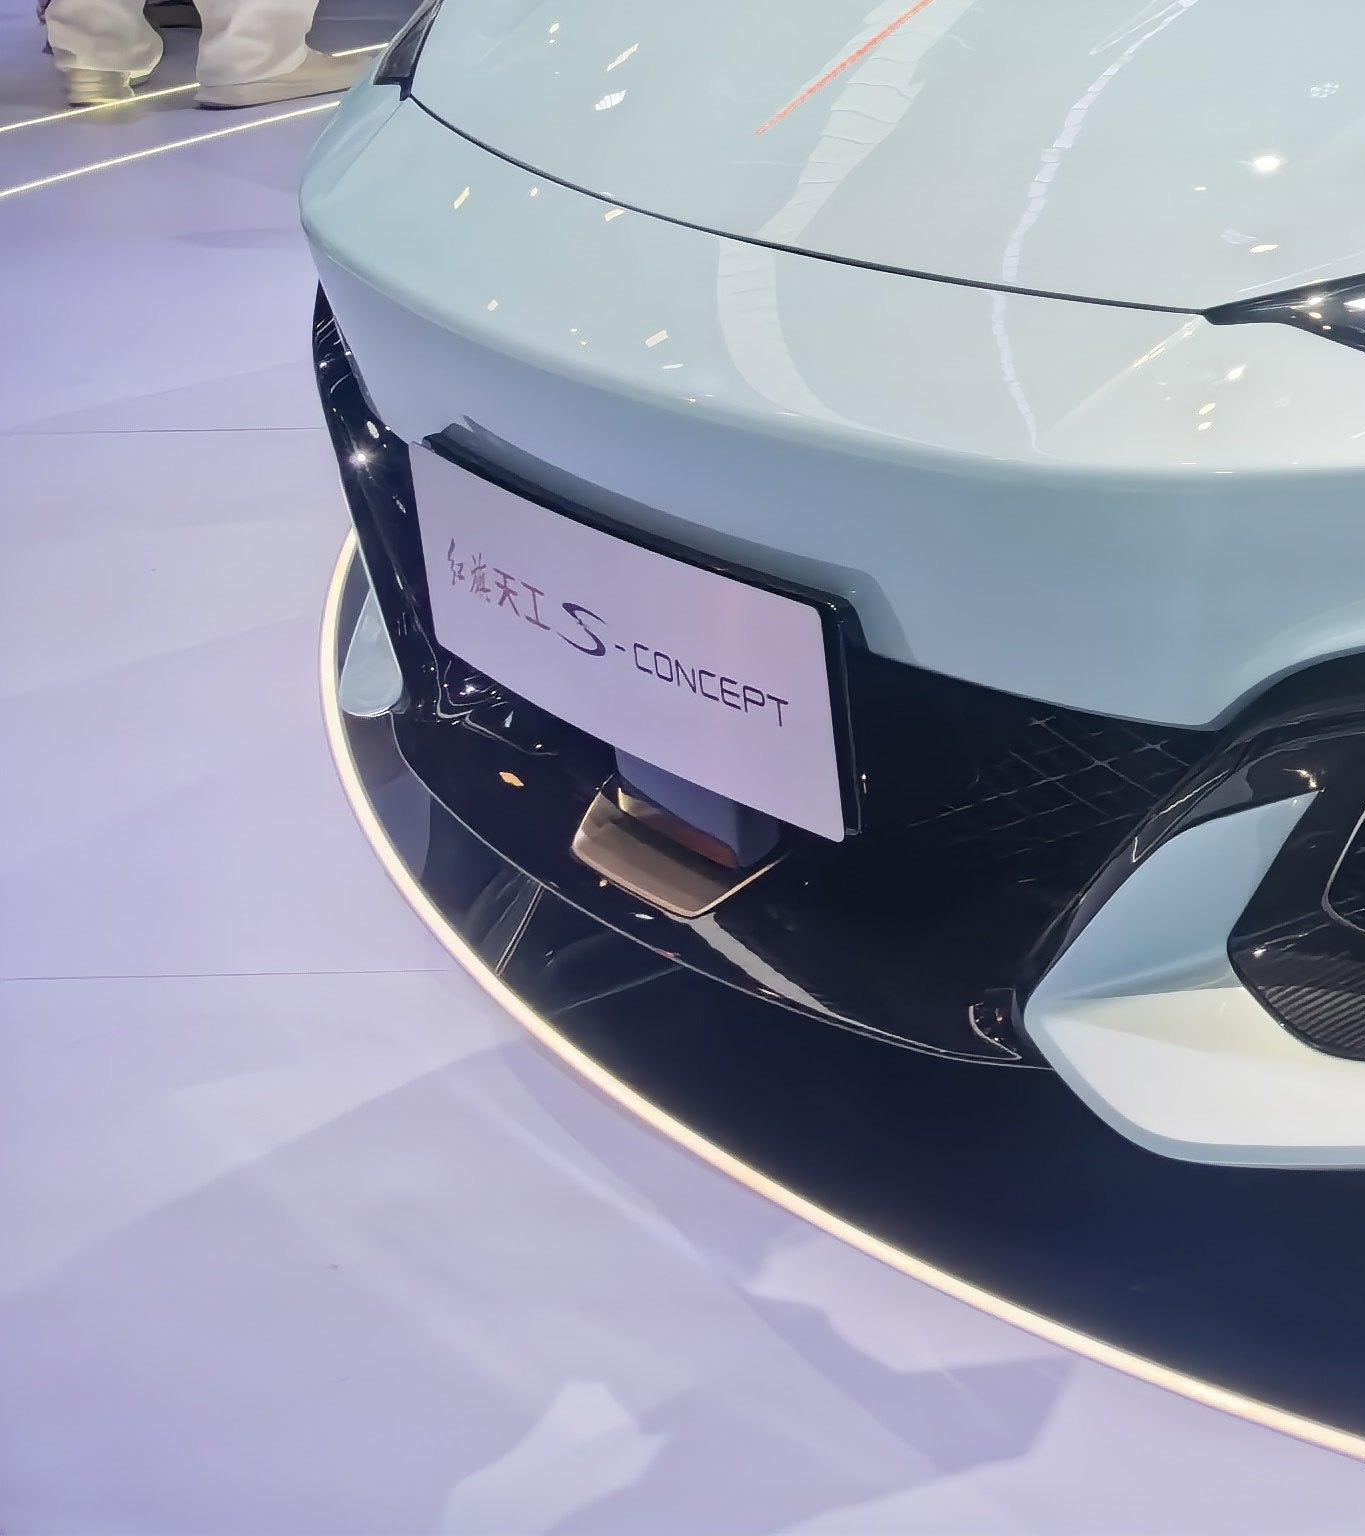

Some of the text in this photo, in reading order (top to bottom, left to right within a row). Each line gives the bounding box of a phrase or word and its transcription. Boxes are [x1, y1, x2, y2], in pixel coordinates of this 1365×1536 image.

[447, 538, 789, 727] 红旗天工 S-CONCEPT
